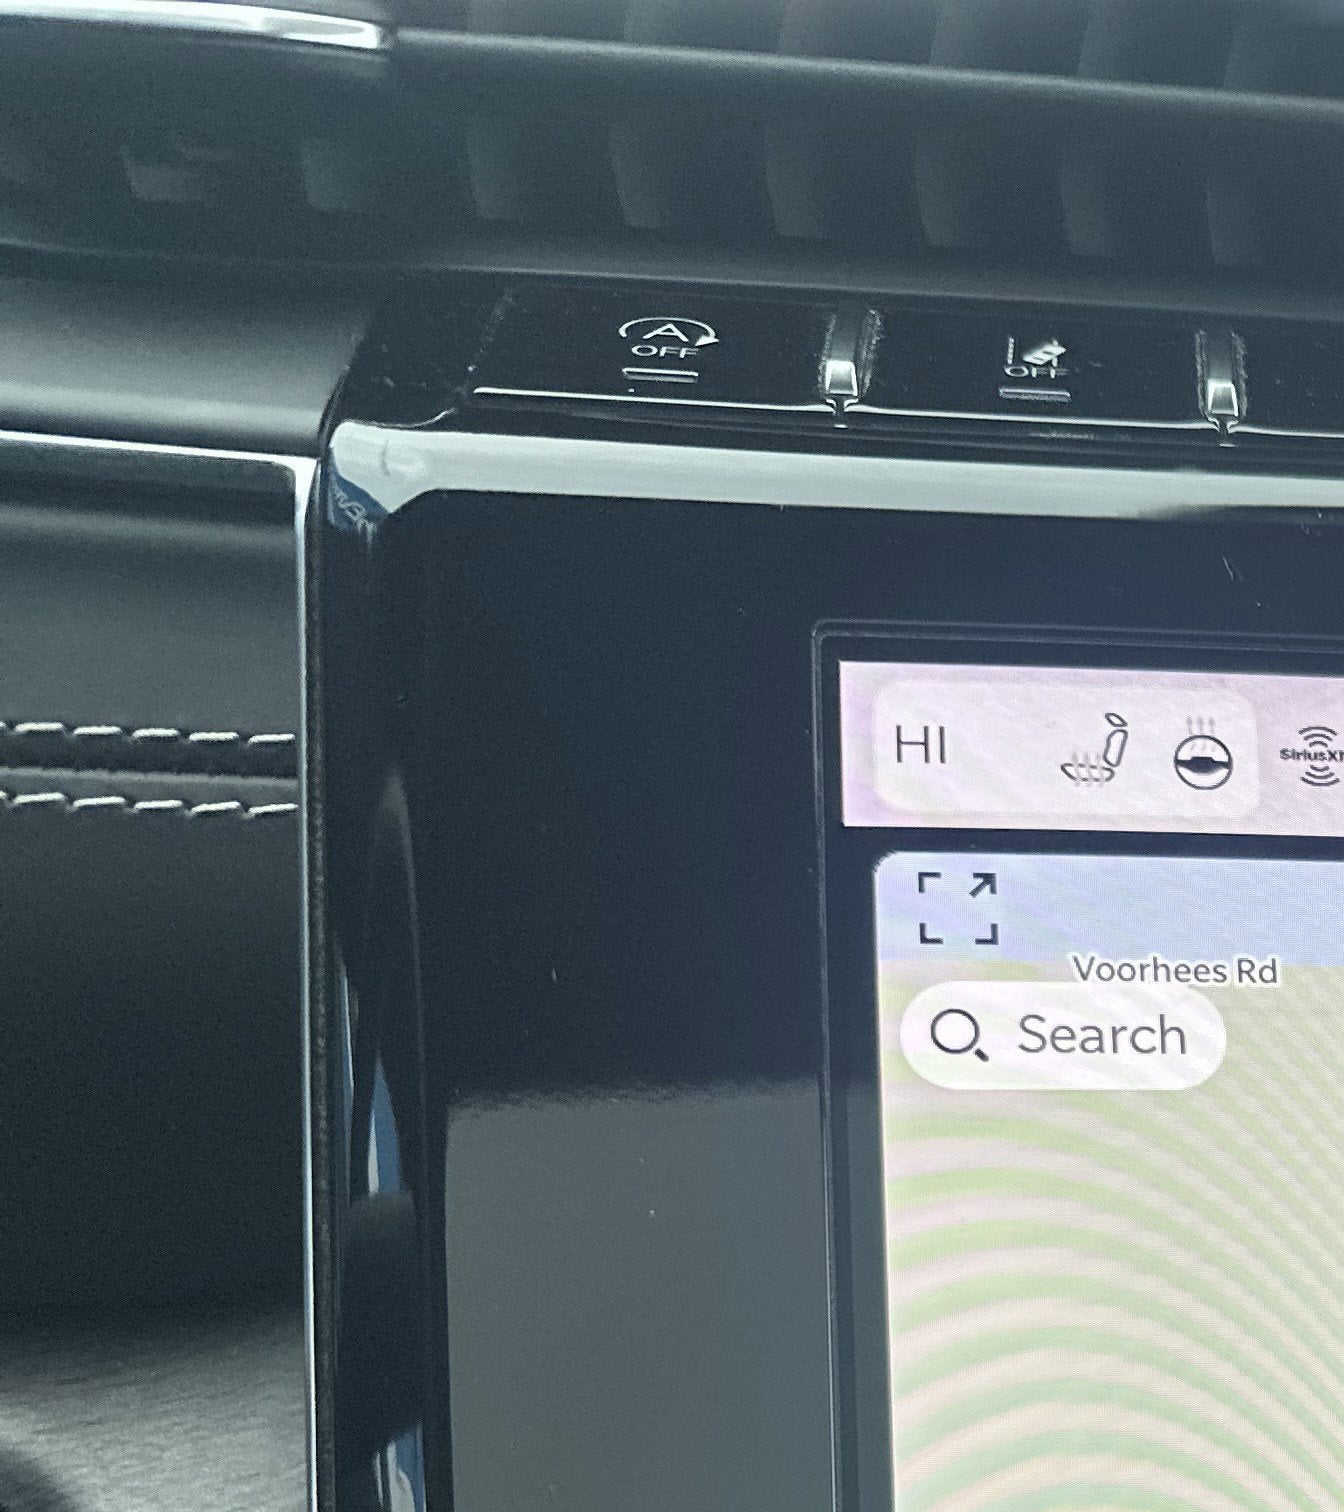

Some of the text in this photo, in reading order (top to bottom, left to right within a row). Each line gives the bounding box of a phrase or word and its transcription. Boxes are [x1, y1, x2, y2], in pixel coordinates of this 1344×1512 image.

[631, 344, 699, 358] OFF
[1004, 364, 1068, 379] OFF
[895, 724, 948, 766] HI
[1073, 954, 1279, 985] Voorhees Rd
[1017, 1012, 1188, 1055] Search
